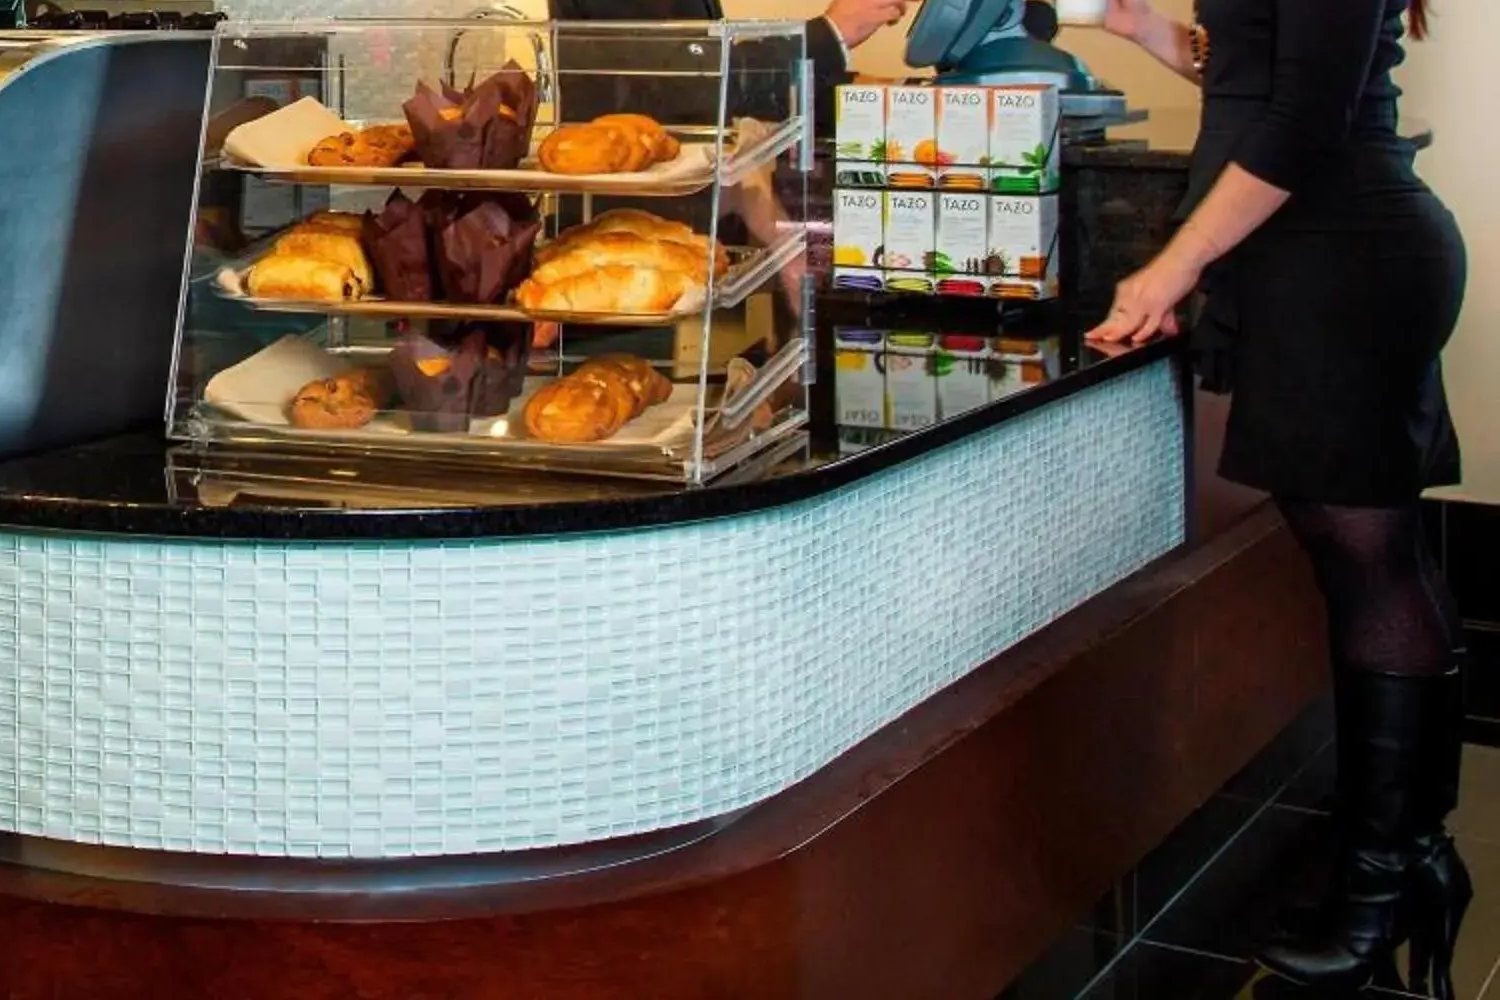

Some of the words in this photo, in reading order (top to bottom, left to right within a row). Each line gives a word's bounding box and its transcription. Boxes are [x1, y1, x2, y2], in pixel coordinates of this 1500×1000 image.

[844, 90, 877, 103] TAZO
[892, 92, 928, 104] TAZO
[943, 93, 980, 105] TAZO
[997, 95, 1035, 108] TAZO
[841, 196, 876, 208] TAZO
[892, 197, 927, 209] TAZO
[944, 197, 980, 211] TAZO
[996, 201, 1033, 214] TAZO
